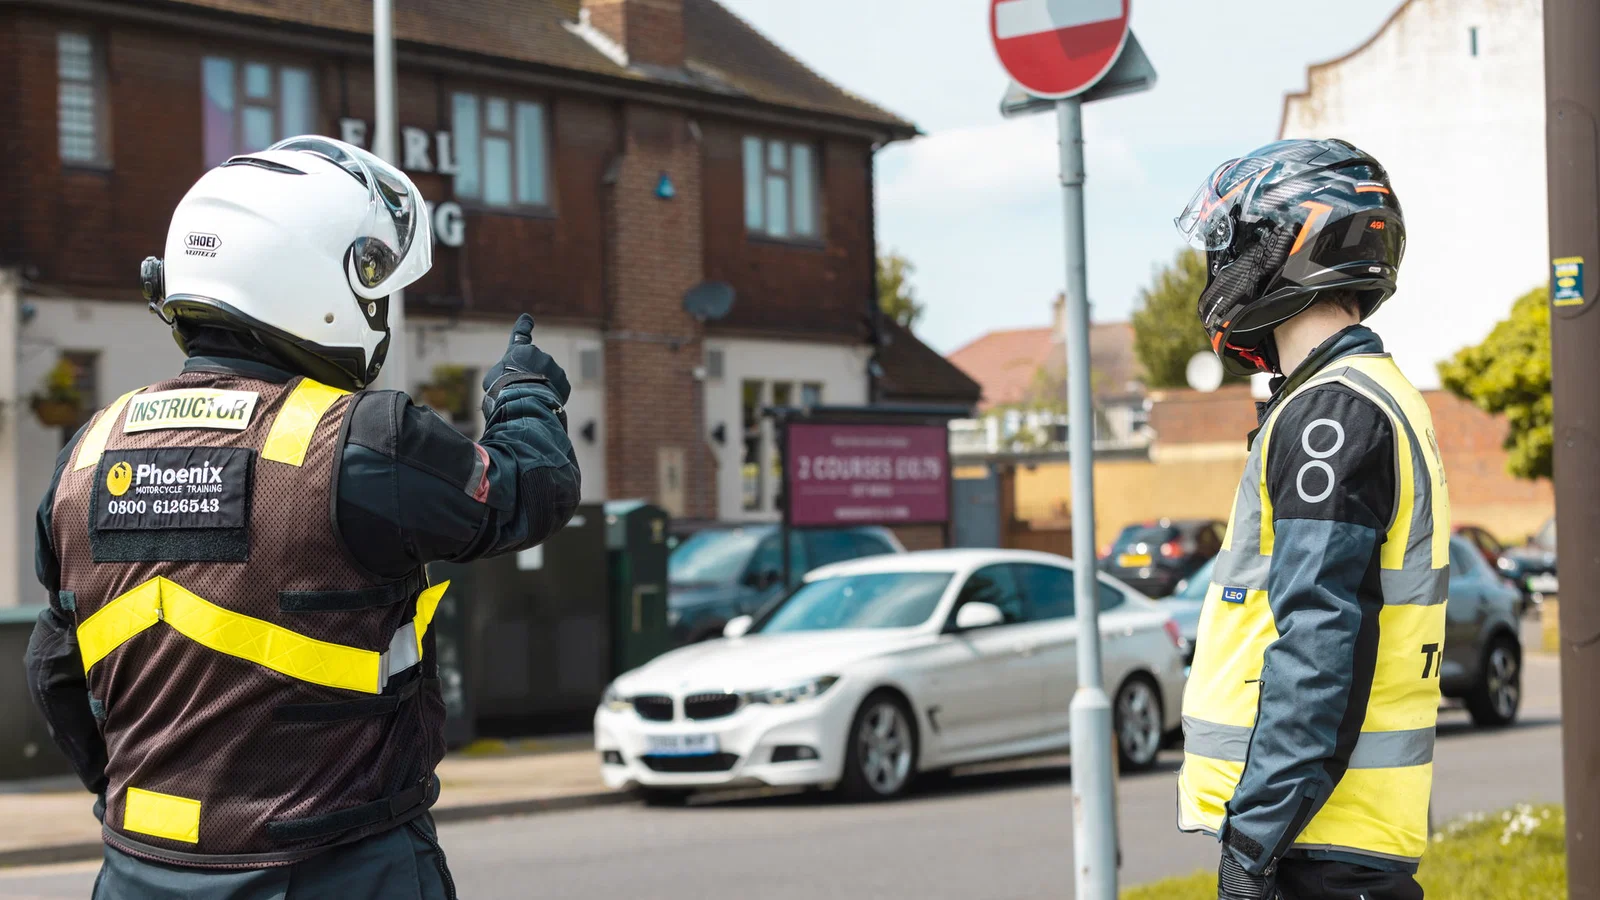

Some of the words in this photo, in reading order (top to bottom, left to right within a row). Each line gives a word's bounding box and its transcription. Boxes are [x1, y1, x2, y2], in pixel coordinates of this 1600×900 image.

[1369, 221, 1385, 230] 491
[188, 234, 216, 248] SHOEI
[130, 397, 248, 423] INSTRUCTOR
[136, 461, 223, 485] Phoenix
[136, 485, 182, 494] MOTORCYCLE
[187, 484, 222, 493] TRAINING
[108, 500, 146, 514] 0800
[153, 498, 220, 514] 6126543
[1225, 591, 1243, 600] LEO
